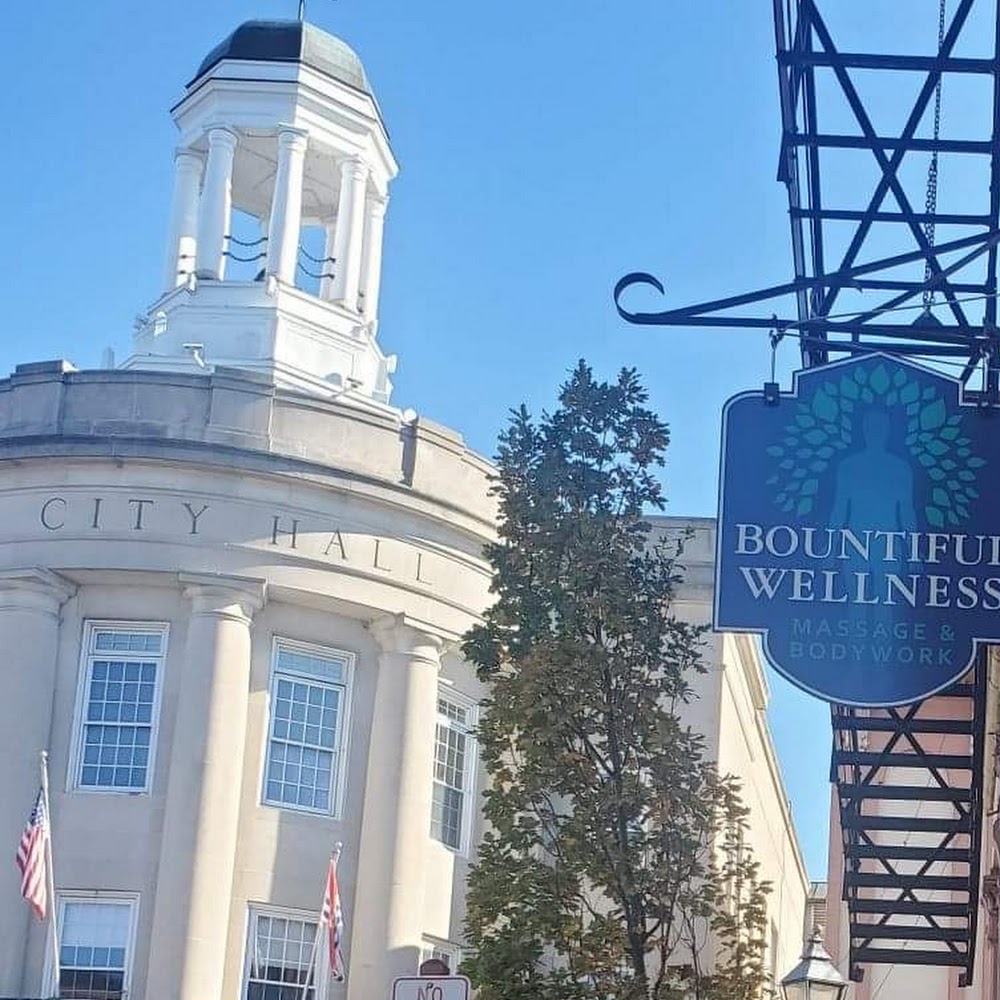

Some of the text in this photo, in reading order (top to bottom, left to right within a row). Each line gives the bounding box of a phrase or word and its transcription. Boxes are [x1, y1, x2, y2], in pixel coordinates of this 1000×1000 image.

[41, 497, 433, 585] CITY HALL
[792, 617, 956, 642] MASSAGE &
[789, 641, 954, 666] BODYWORK
